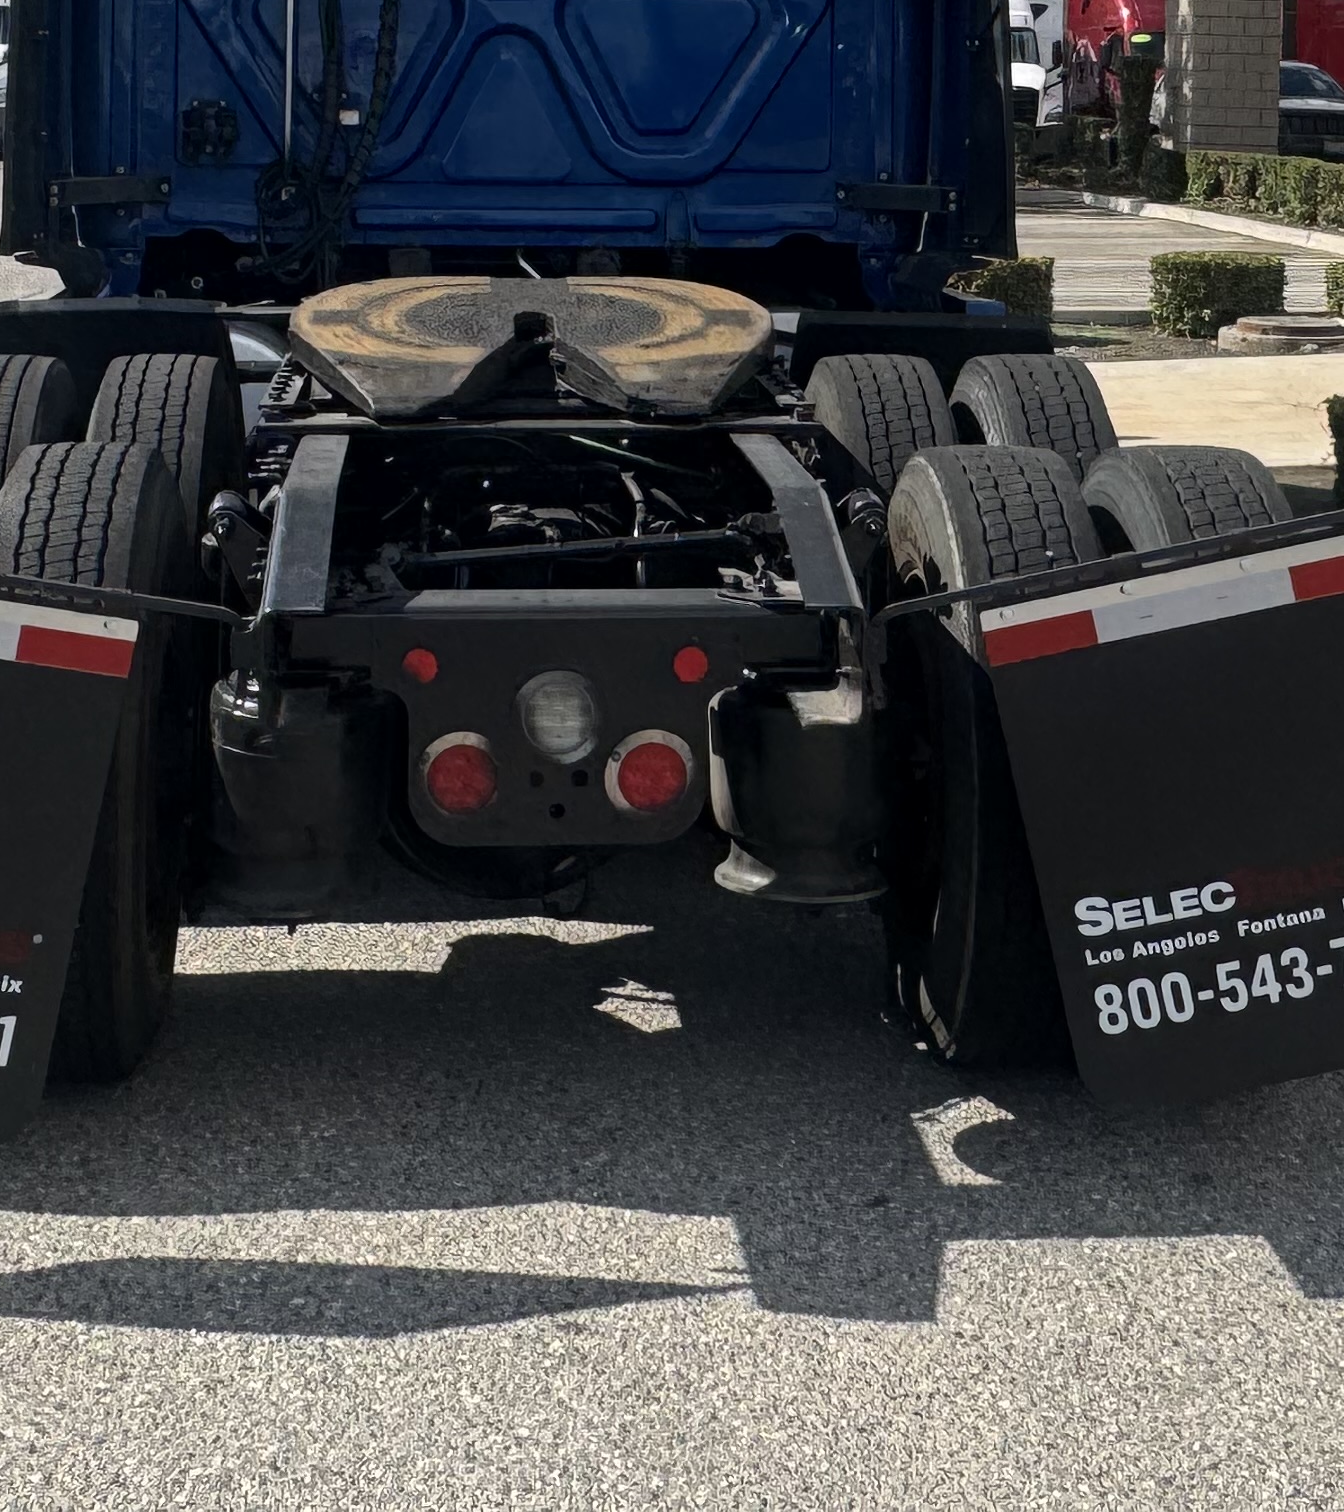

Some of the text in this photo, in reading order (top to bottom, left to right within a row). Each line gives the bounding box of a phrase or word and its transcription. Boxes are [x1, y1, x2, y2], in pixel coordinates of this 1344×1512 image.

[1084, 948, 1125, 967] Los
[1132, 929, 1221, 960] Angeles
[1237, 906, 1326, 938] Fontana
